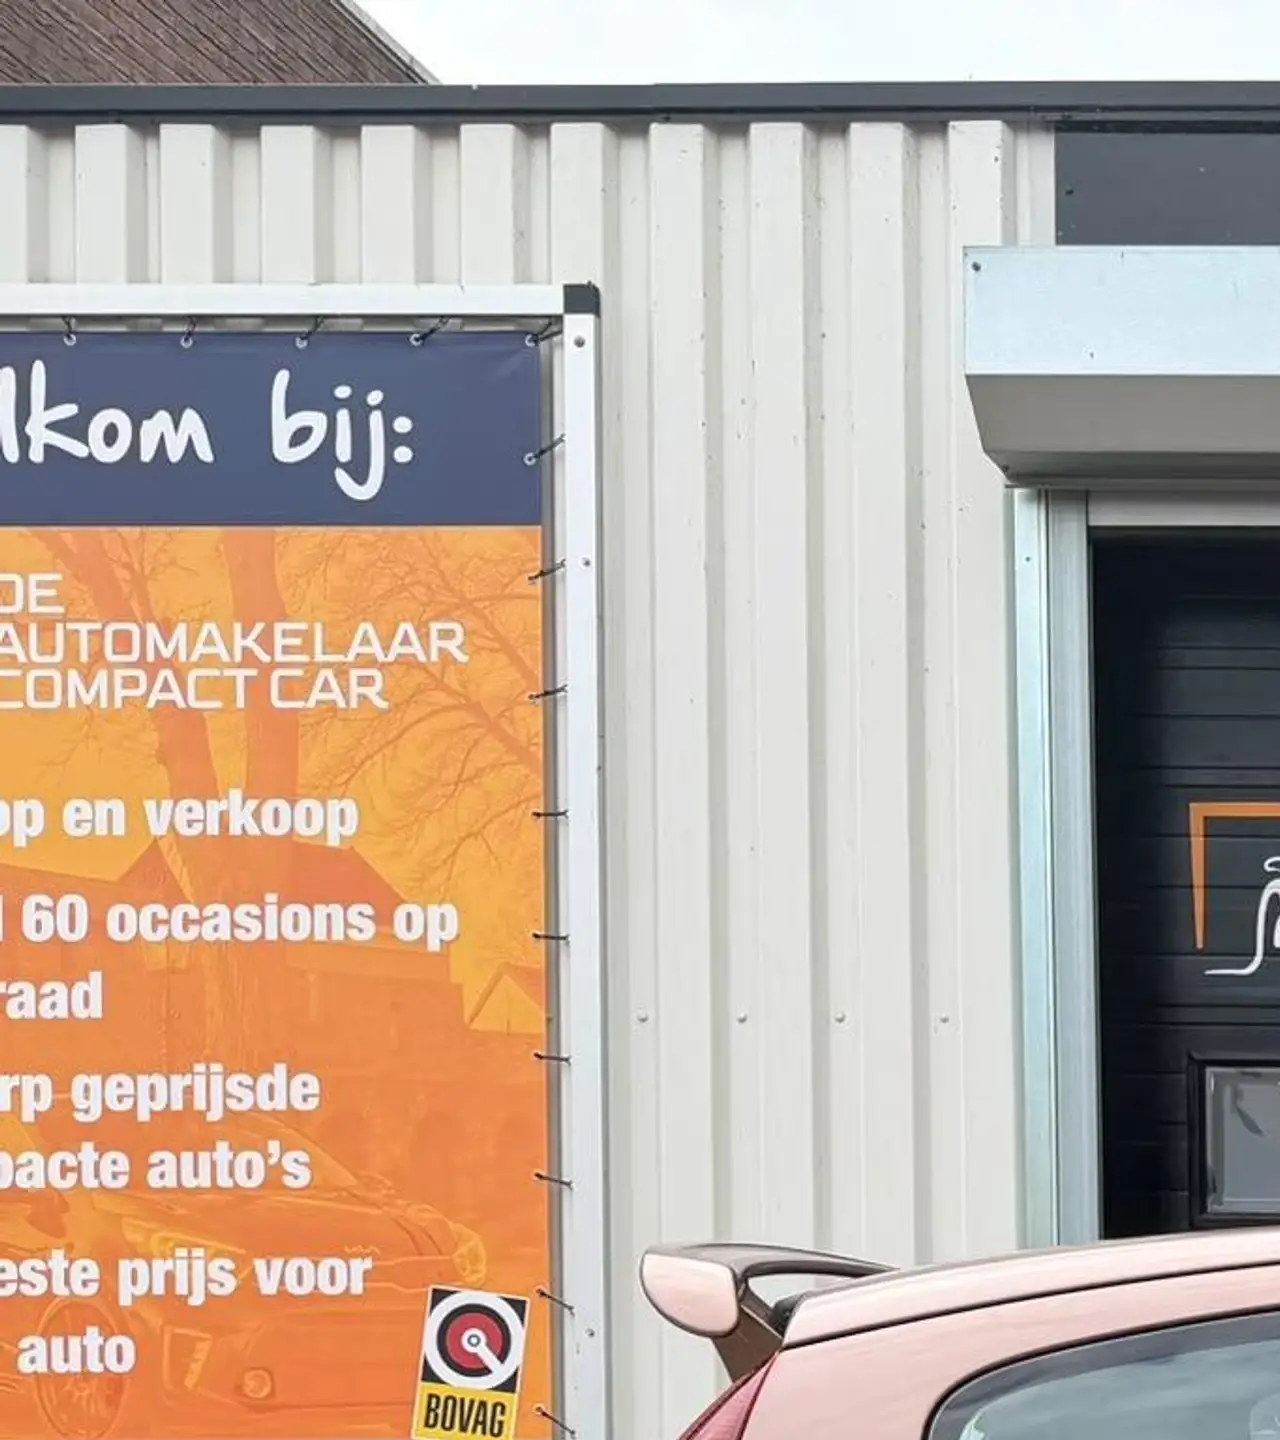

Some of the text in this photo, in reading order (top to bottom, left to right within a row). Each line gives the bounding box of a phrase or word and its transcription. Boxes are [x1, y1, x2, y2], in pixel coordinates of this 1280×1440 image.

[272, 368, 413, 500] bij:
[0, 622, 469, 664] AUTOMAKELAAR
[270, 668, 389, 709] CAR
[62, 798, 126, 837] en
[144, 788, 359, 847] verkoop
[22, 894, 89, 942] 60
[106, 893, 376, 942] occasions
[393, 903, 459, 951] op
[71, 1063, 320, 1123] geprijsde
[118, 1247, 237, 1306] prijs
[253, 1256, 373, 1296] voor
[18, 1326, 136, 1374] auto
[424, 1393, 507, 1438] BOVAG
